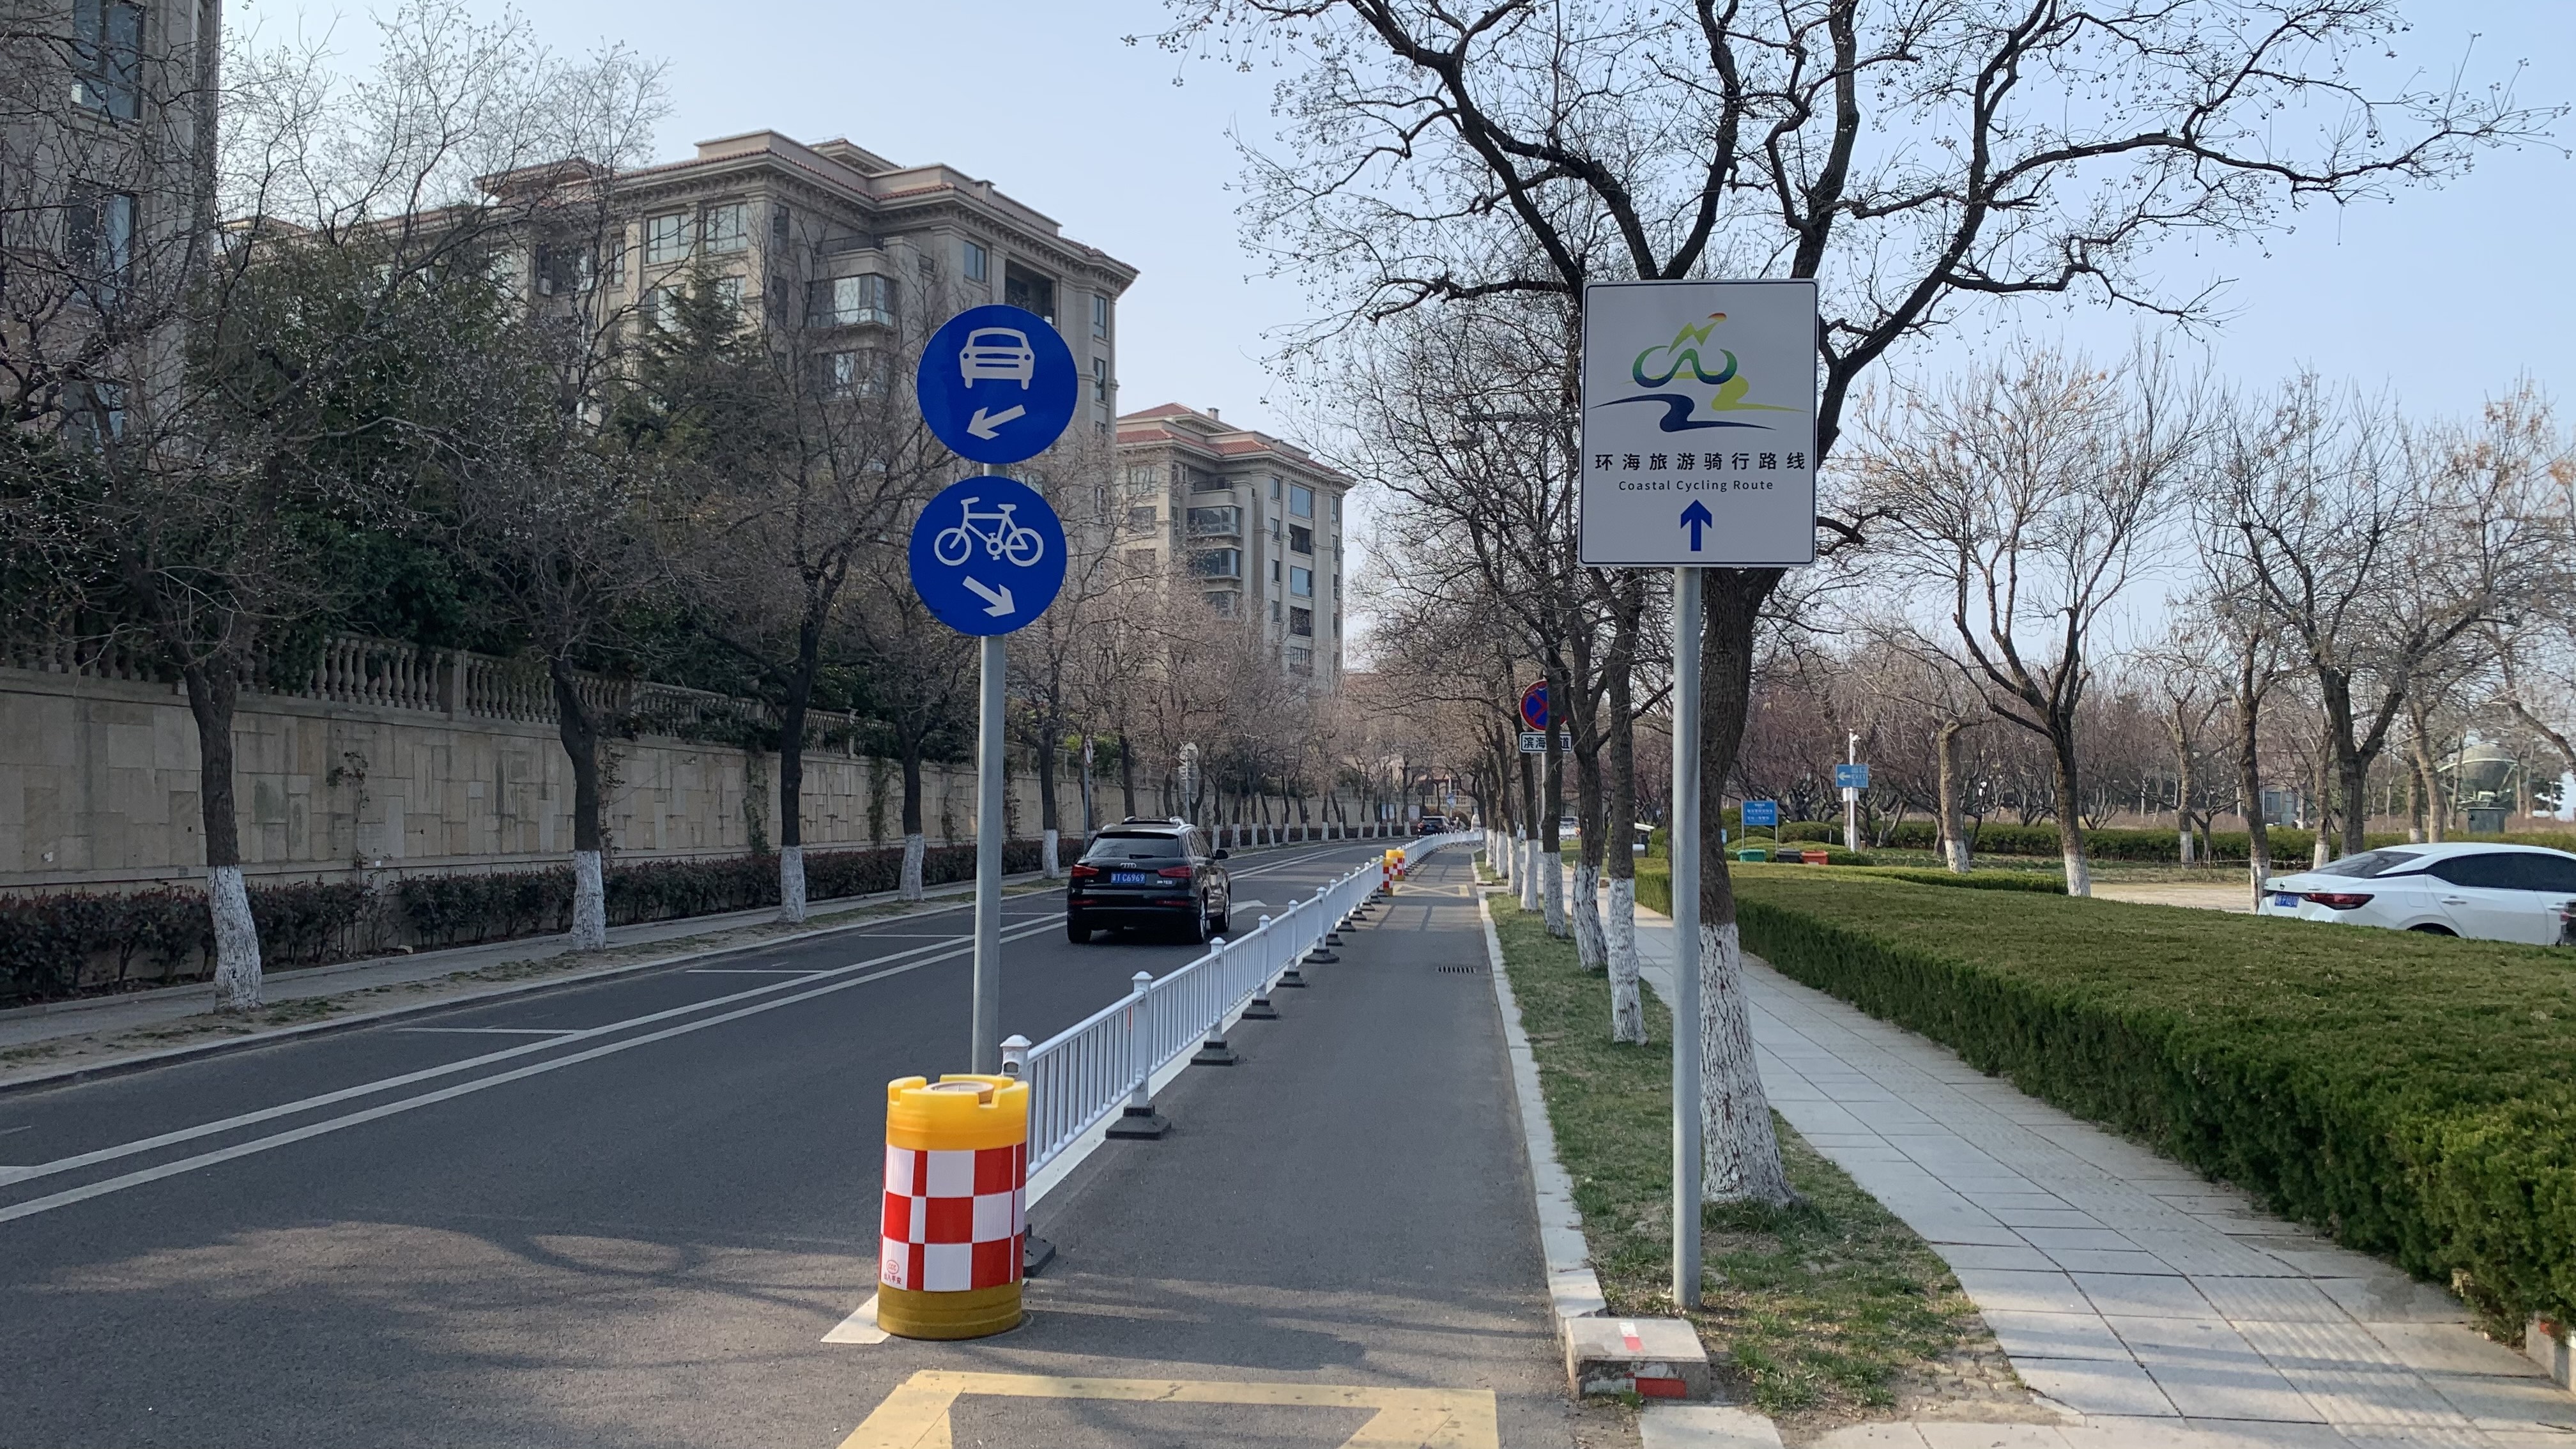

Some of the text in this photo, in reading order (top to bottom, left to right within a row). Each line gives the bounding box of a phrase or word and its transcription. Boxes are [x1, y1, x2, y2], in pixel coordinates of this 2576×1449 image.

[1595, 452, 1805, 471] 环海旅游骑行路线
[1618, 480, 1774, 492] Coastal Cycling Route
[1523, 736, 1570, 749] 滨海道
